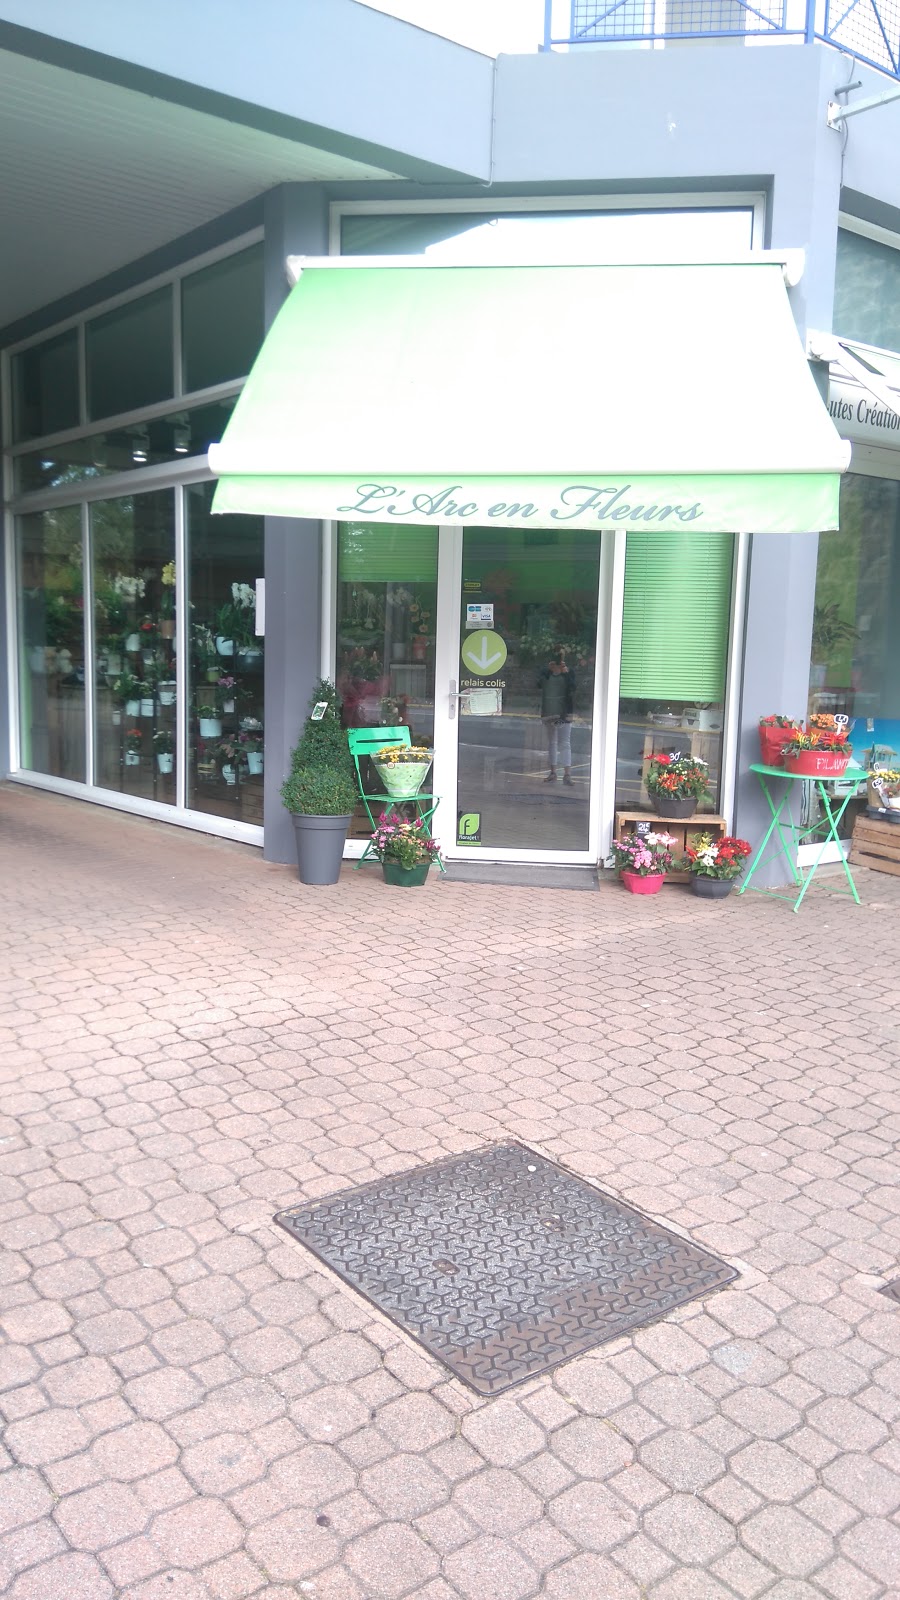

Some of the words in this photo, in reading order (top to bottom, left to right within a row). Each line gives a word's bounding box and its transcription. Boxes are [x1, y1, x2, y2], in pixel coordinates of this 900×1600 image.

[827, 398, 854, 421] utes
[336, 483, 479, 517] L'Arc
[487, 500, 539, 518] en
[550, 484, 704, 522] Fleurs
[460, 679, 484, 687] relais
[485, 678, 506, 688] colis
